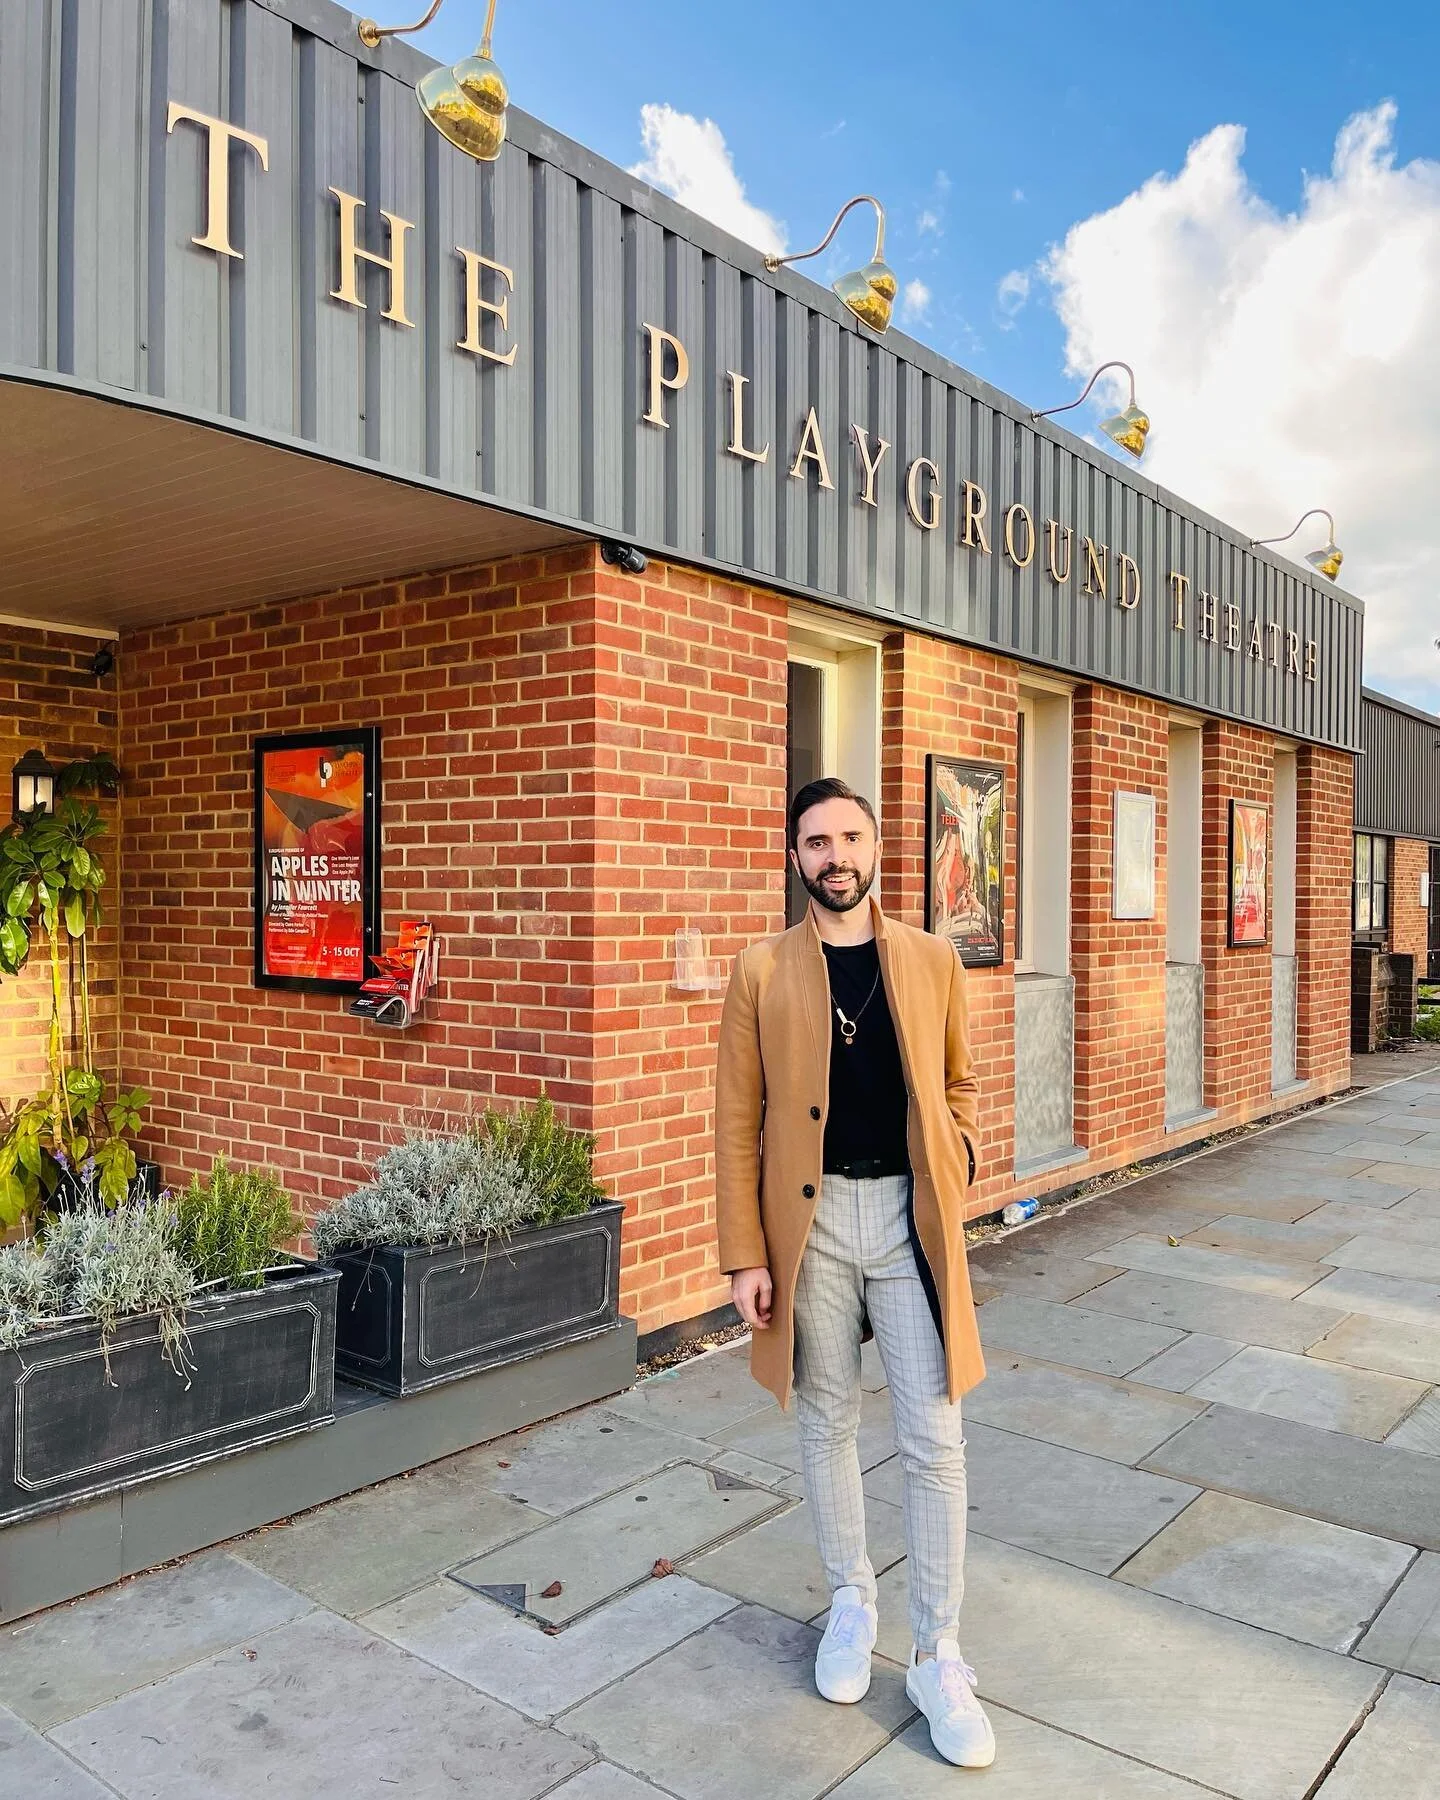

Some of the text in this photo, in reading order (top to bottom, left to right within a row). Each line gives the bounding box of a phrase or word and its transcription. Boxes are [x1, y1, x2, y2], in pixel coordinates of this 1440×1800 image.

[167, 101, 1319, 683] THE PLAYGROUND THEATRE
[271, 855, 329, 877] APPLES
[272, 879, 362, 902] IN WINTER
[271, 904, 278, 912] by
[322, 946, 328, 956] 5
[333, 946, 342, 957] 15
[343, 947, 361, 958] OCT
